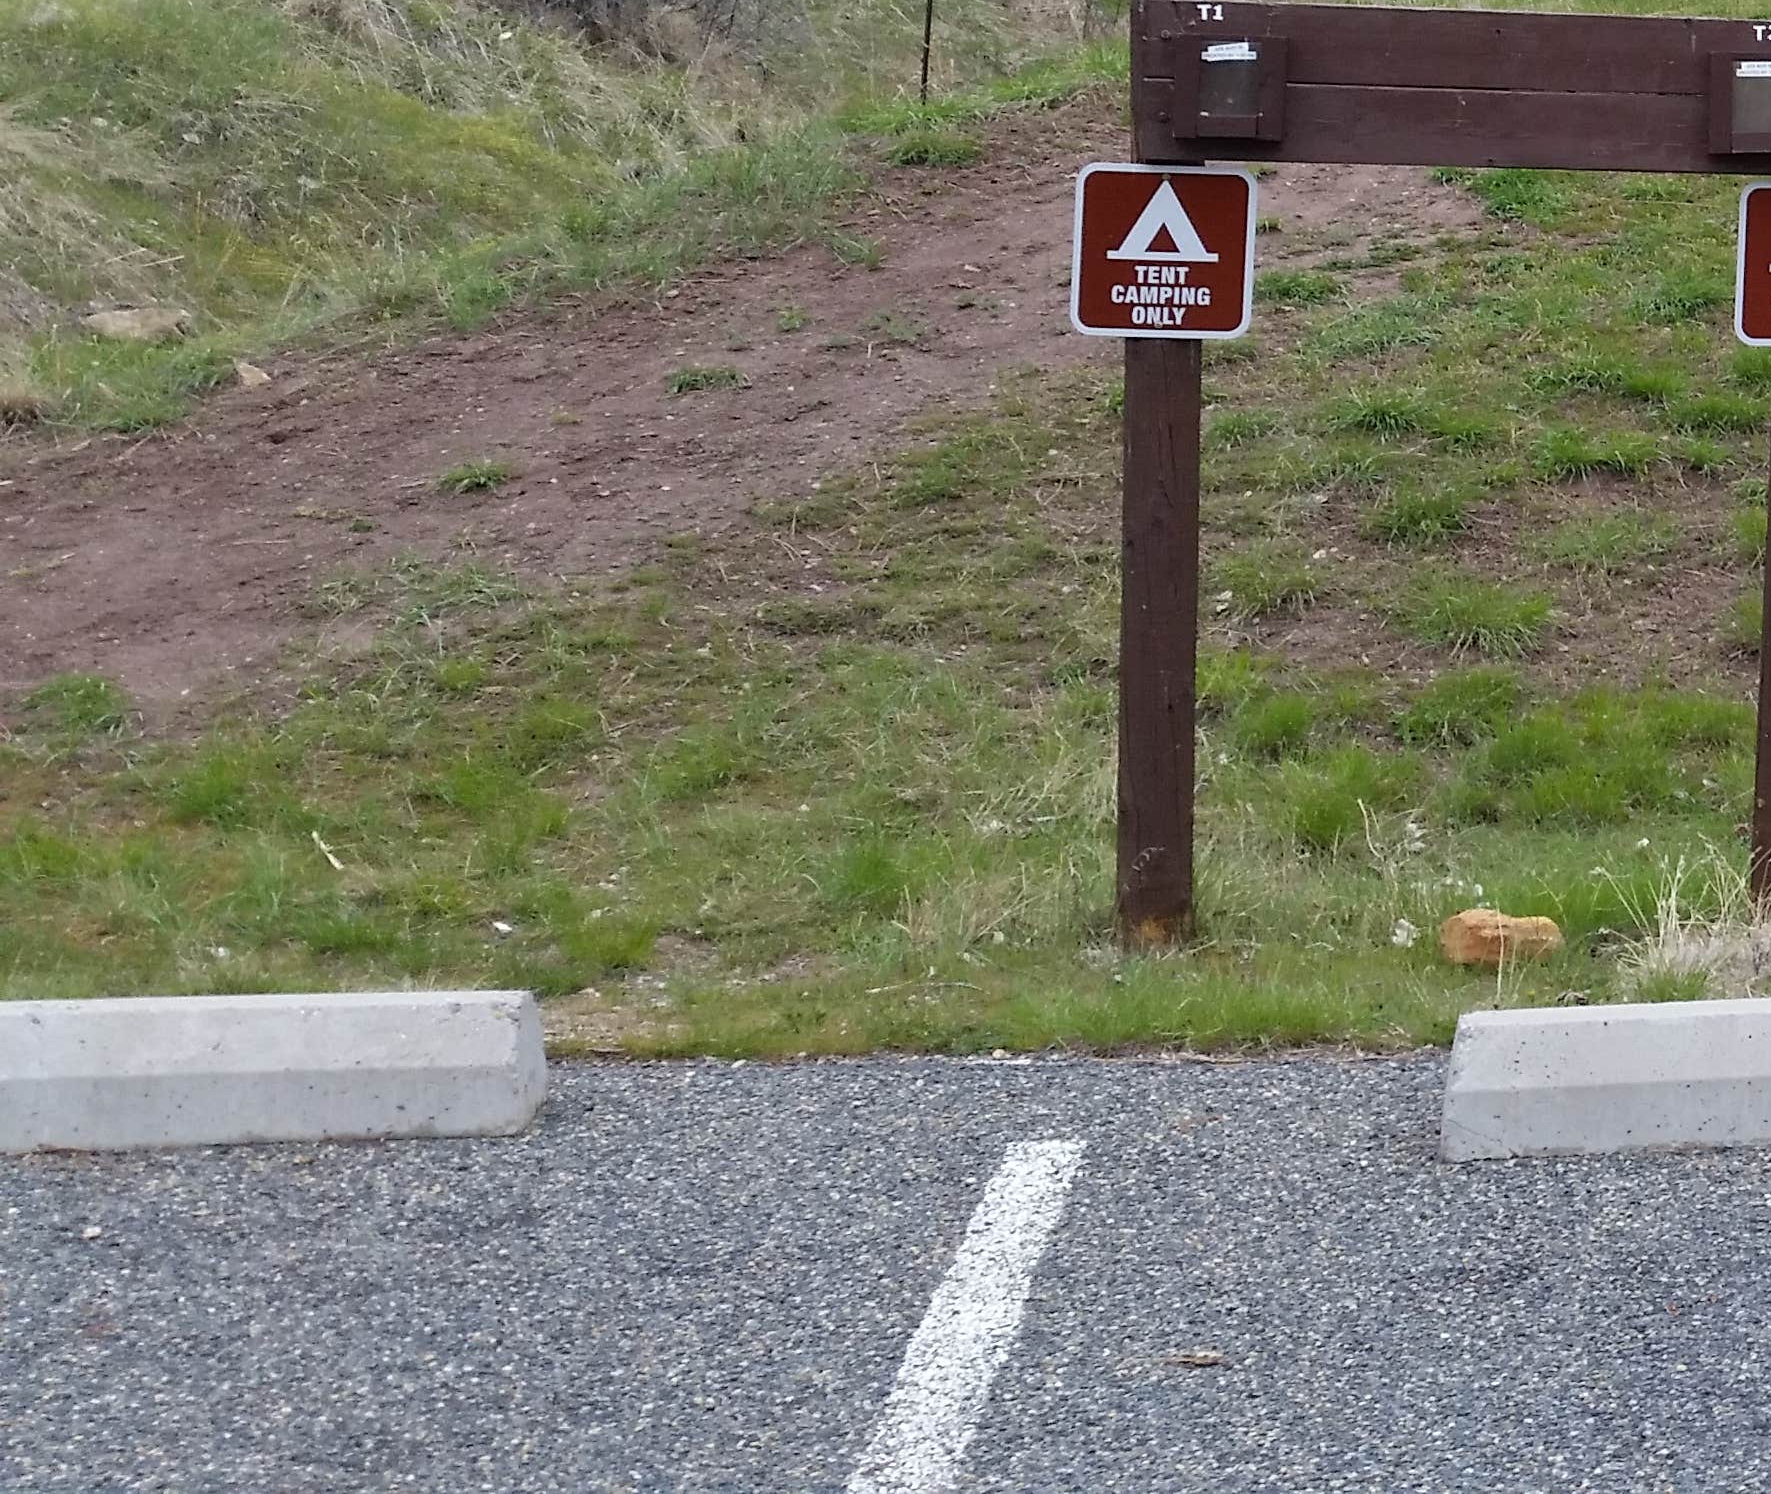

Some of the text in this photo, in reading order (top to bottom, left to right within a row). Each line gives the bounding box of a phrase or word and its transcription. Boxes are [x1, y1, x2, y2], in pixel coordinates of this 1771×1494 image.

[1196, 4, 1224, 21] T1
[1134, 265, 1190, 285] TENT
[1111, 284, 1211, 306] CAMPING
[1131, 306, 1186, 326] ONLY
